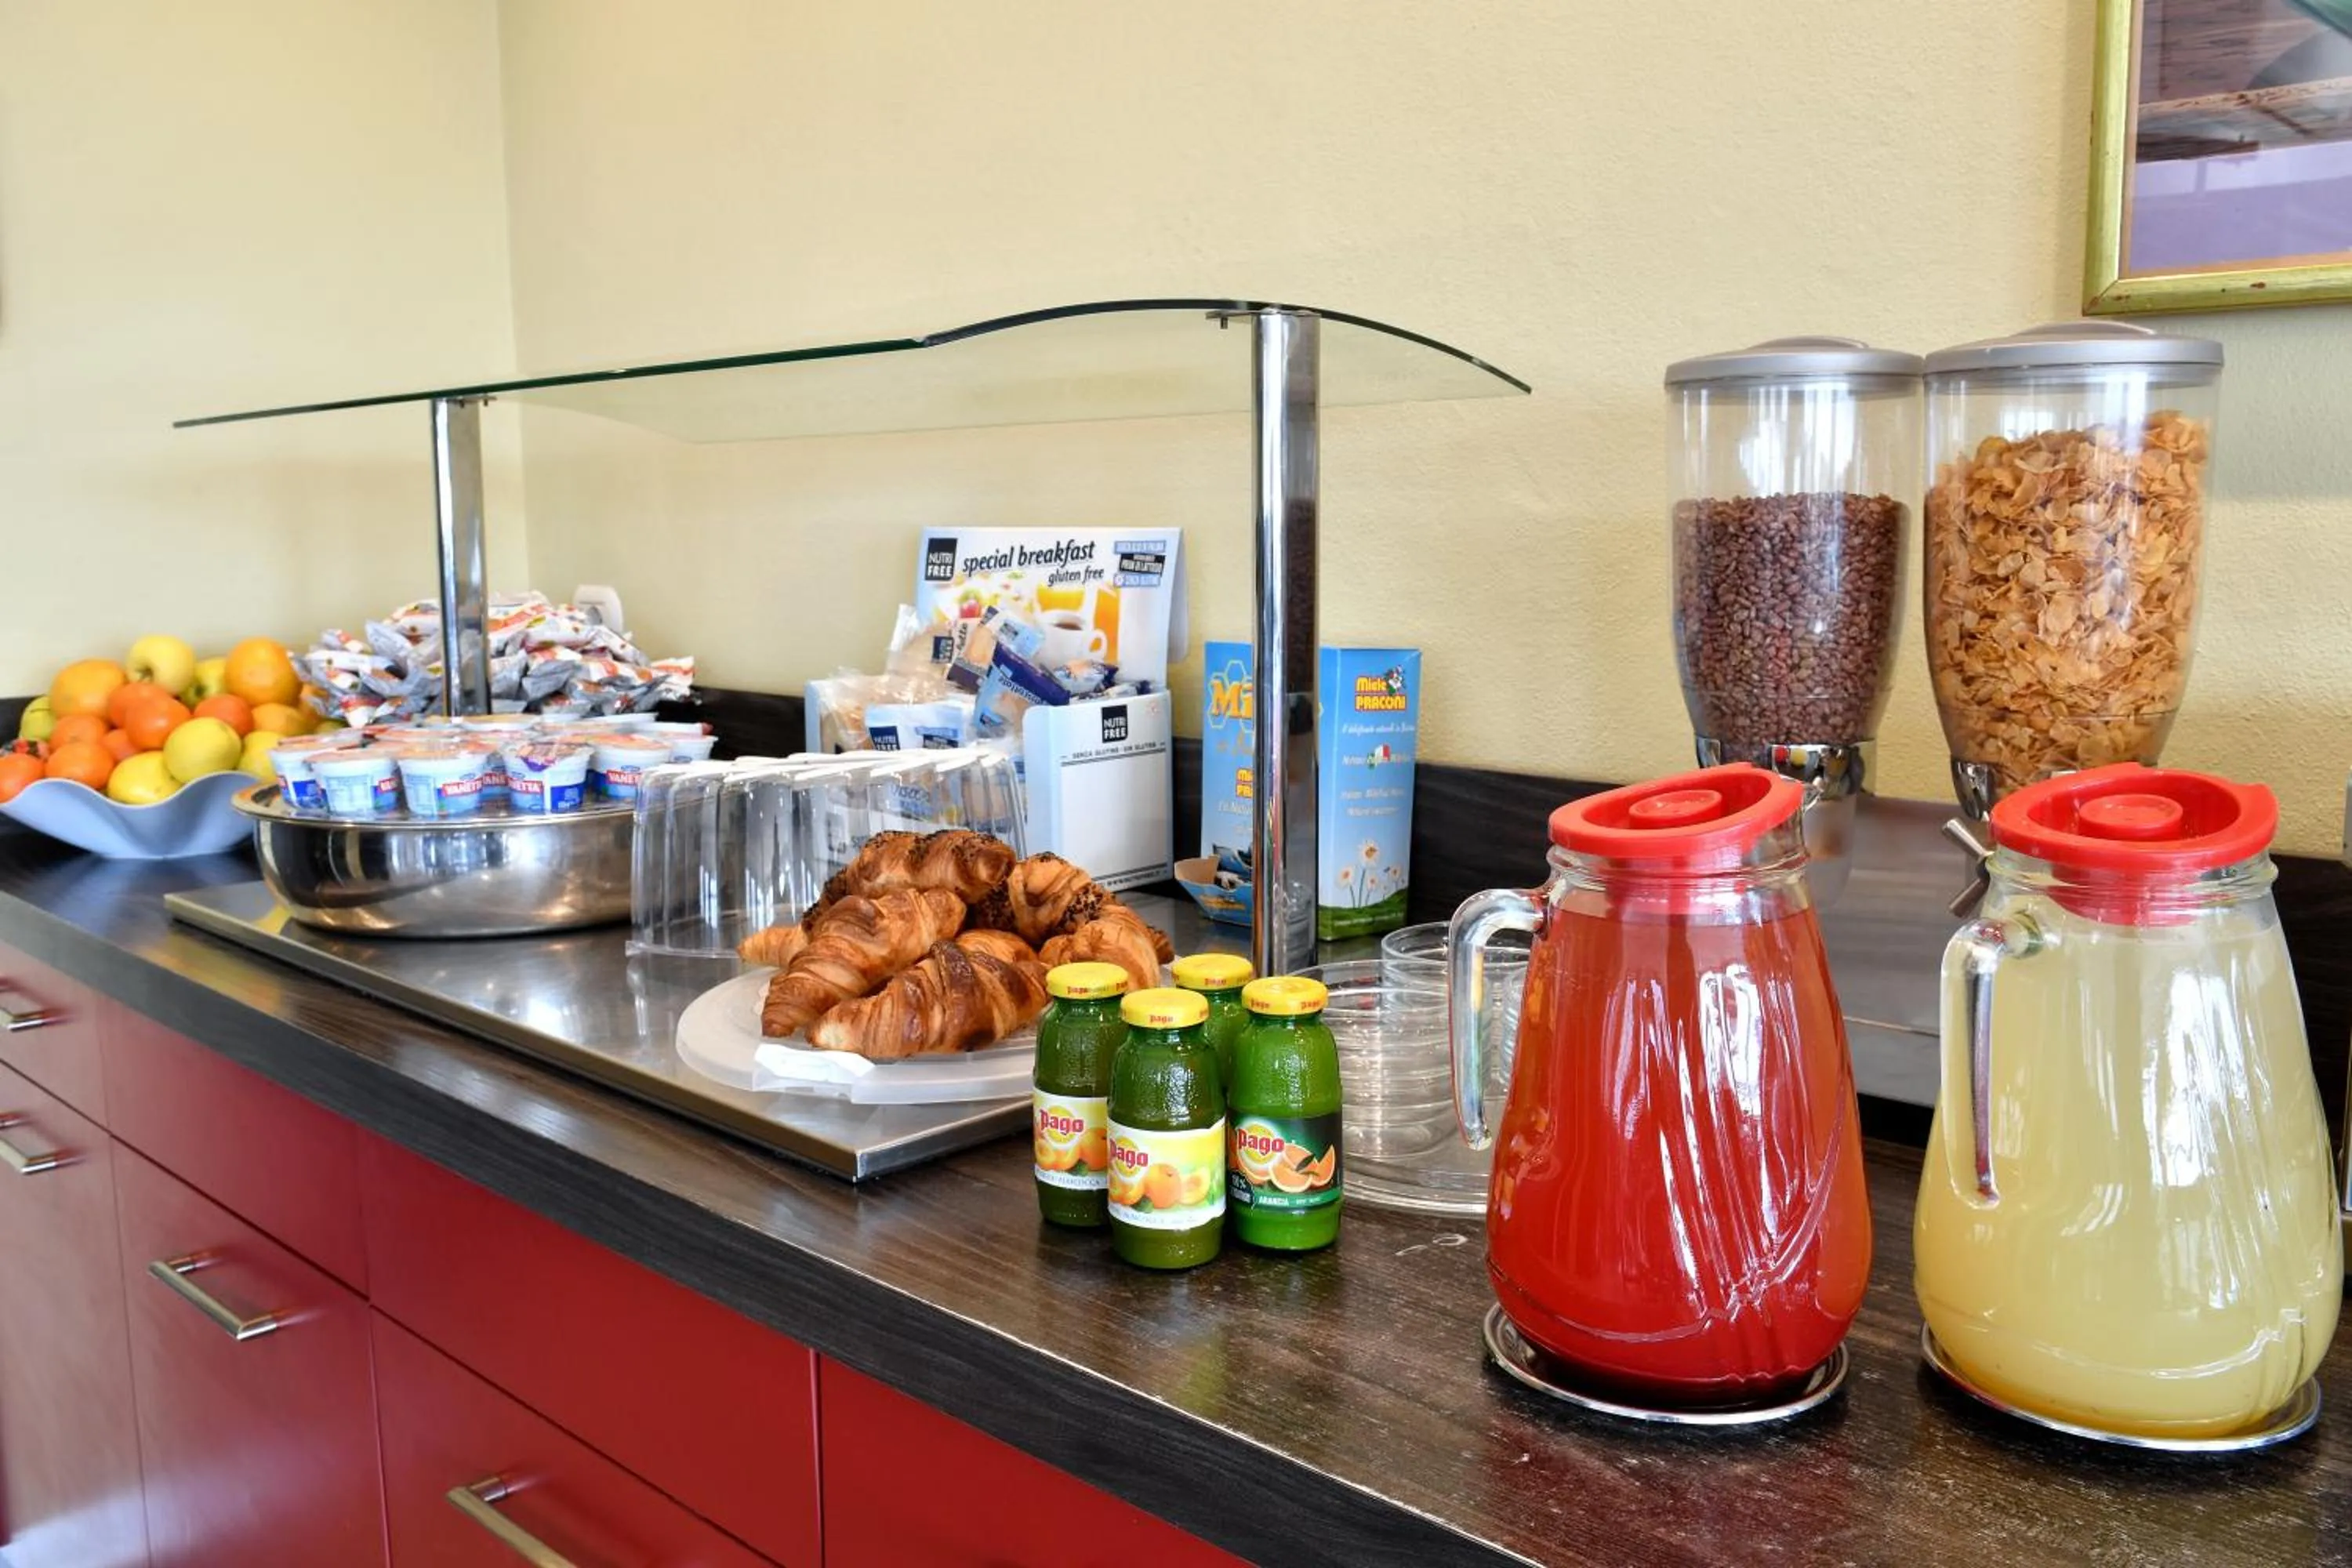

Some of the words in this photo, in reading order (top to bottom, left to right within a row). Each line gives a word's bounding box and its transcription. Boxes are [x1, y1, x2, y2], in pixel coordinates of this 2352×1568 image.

[928, 552, 953, 564] NUTRI
[963, 546, 1014, 577] special
[1019, 539, 1096, 568] breakfast
[927, 565, 953, 577] FREE
[1048, 568, 1081, 586] gluten
[1082, 566, 1105, 585] free
[1356, 695, 1406, 710] PRACONI
[1103, 716, 1127, 728] NUTRI
[873, 735, 896, 744] NUTRI
[1104, 727, 1127, 739] FREE
[1149, 1014, 1174, 1024] pago
[1040, 1109, 1084, 1135] pago
[1237, 1128, 1285, 1156] pago
[1109, 1138, 1149, 1169] pago
